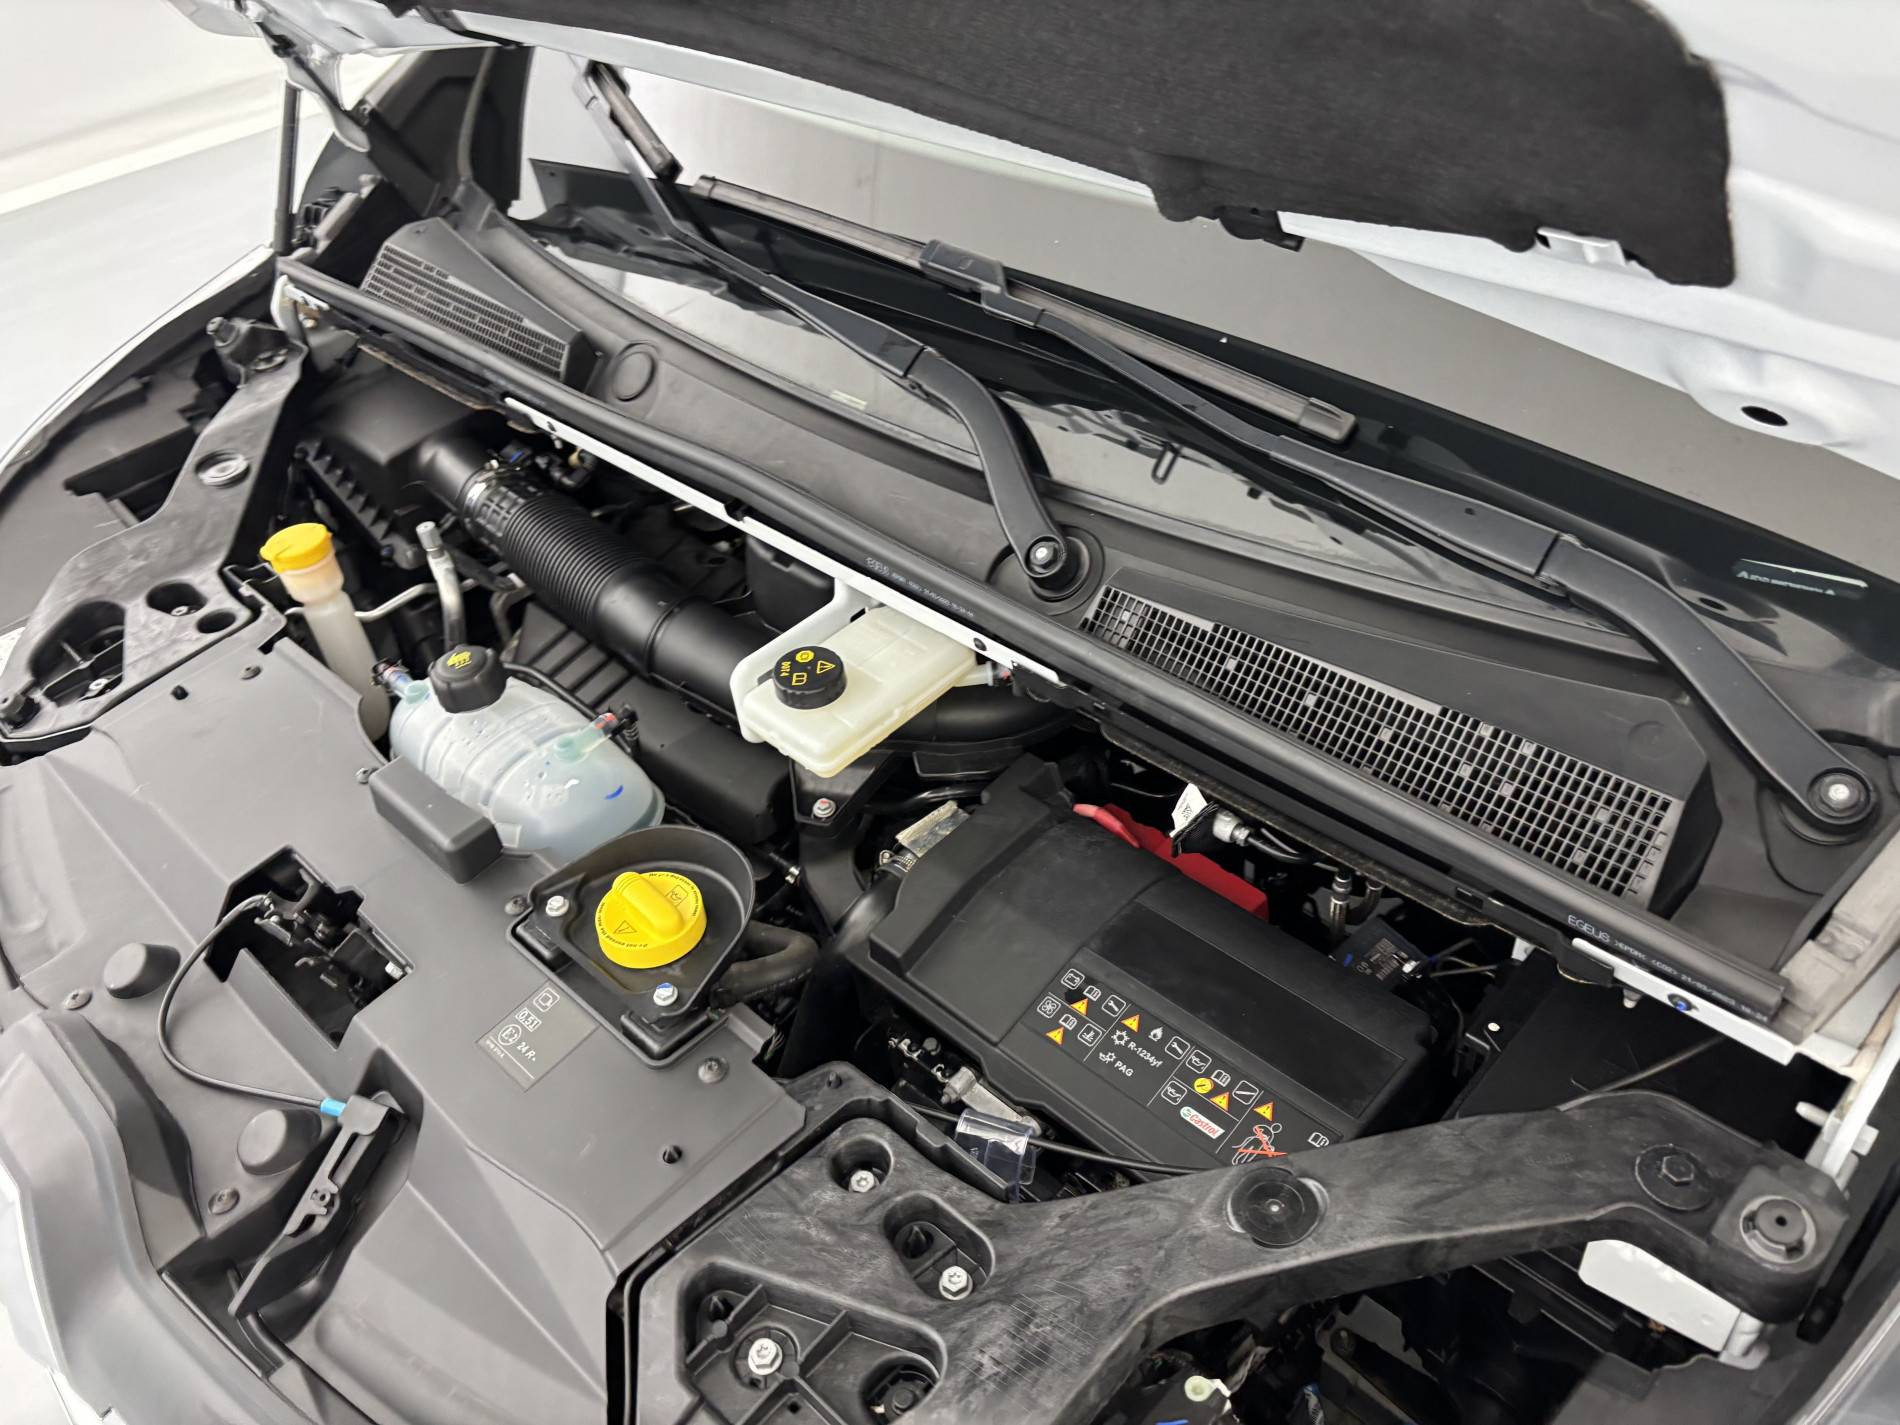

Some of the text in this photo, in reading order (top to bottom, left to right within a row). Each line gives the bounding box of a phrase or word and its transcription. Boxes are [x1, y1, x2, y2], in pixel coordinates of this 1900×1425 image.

[1128, 1041, 1163, 1068] R-1234yf
[1114, 1060, 1134, 1078] PAG
[1190, 1113, 1219, 1137] Castrol
